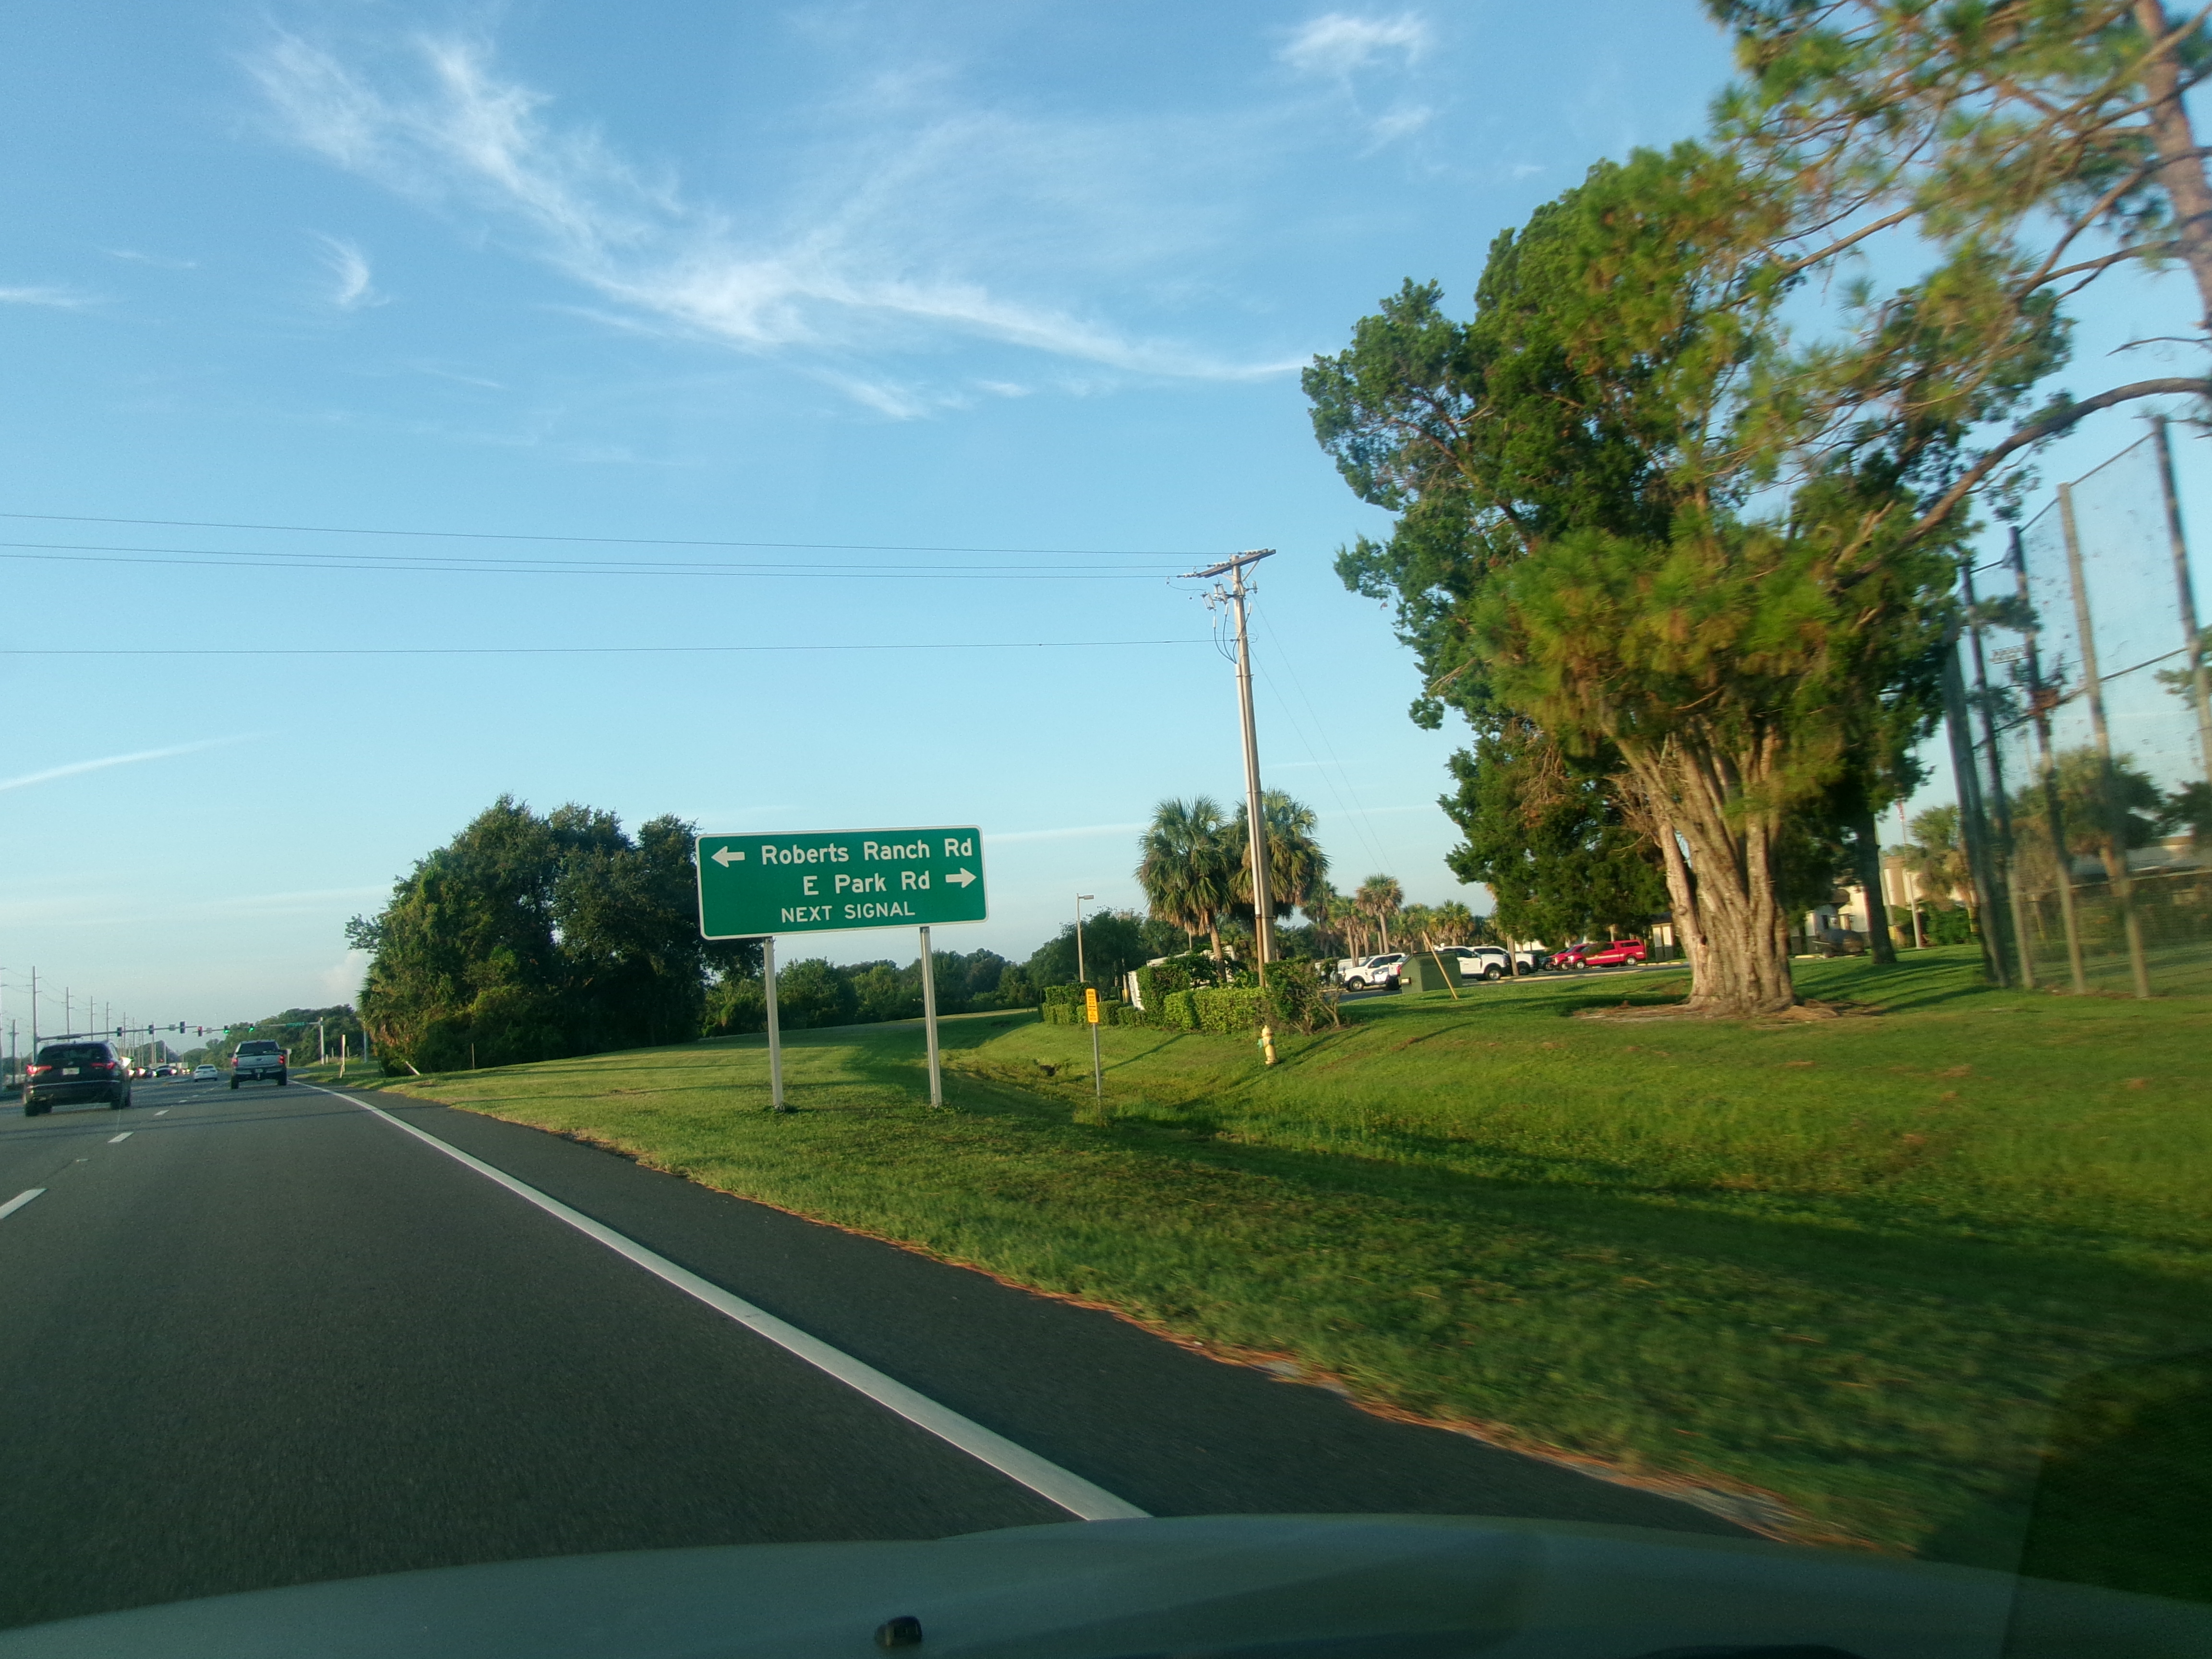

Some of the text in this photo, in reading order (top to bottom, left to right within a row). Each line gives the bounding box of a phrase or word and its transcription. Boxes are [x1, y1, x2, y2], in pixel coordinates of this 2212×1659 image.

[761, 838, 973, 865] Roberts Ranch Rd
[803, 870, 930, 895] E Park Rd
[781, 901, 915, 923] NEXT SIGNAL
